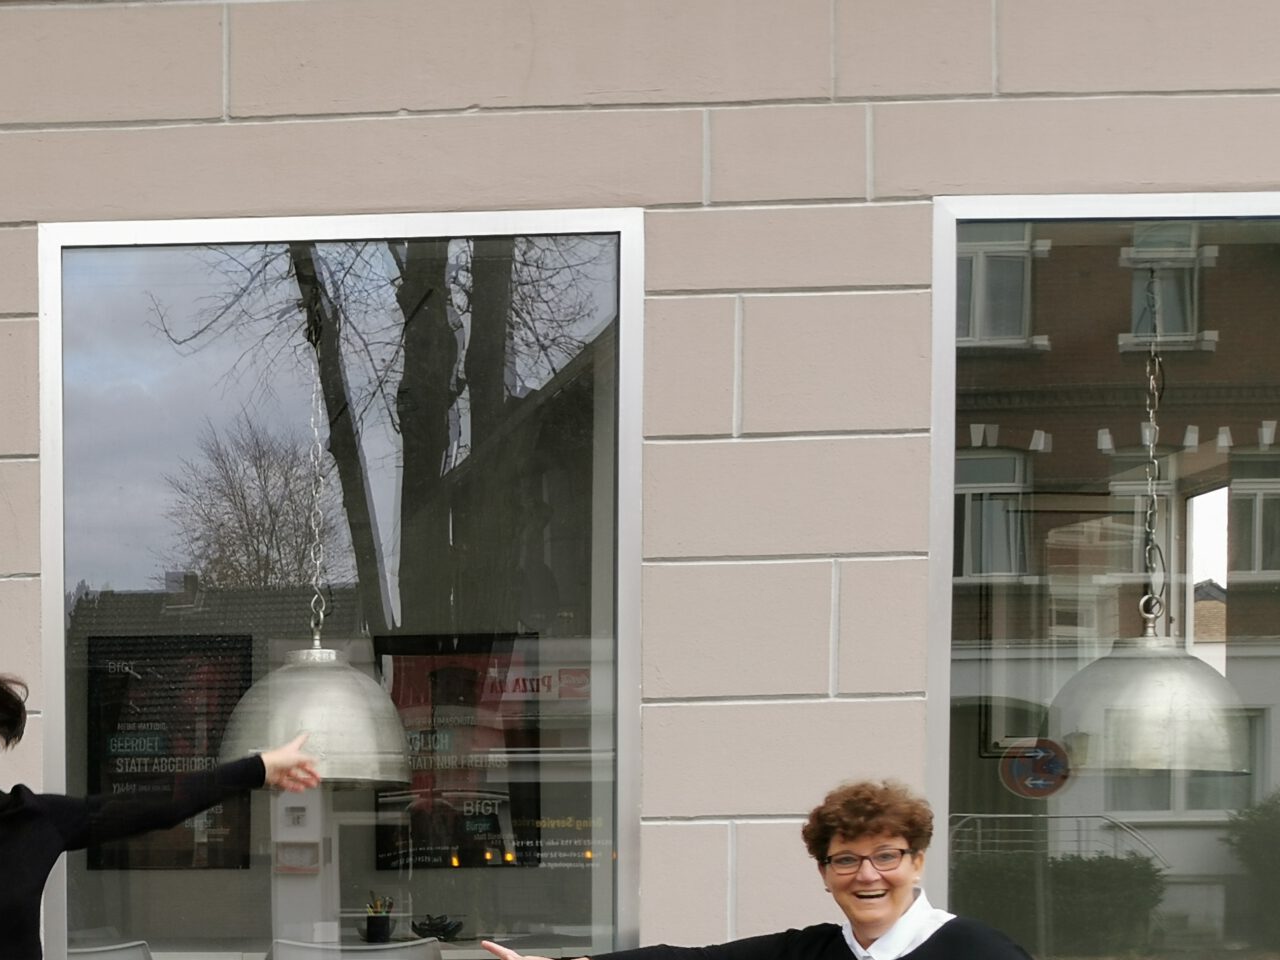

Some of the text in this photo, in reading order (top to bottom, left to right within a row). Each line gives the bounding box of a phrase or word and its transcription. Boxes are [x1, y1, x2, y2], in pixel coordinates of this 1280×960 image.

[110, 737, 160, 752] GEERDET
[116, 756, 220, 773] STATT ABGEHOBEN
[463, 800, 501, 816] BfGT
